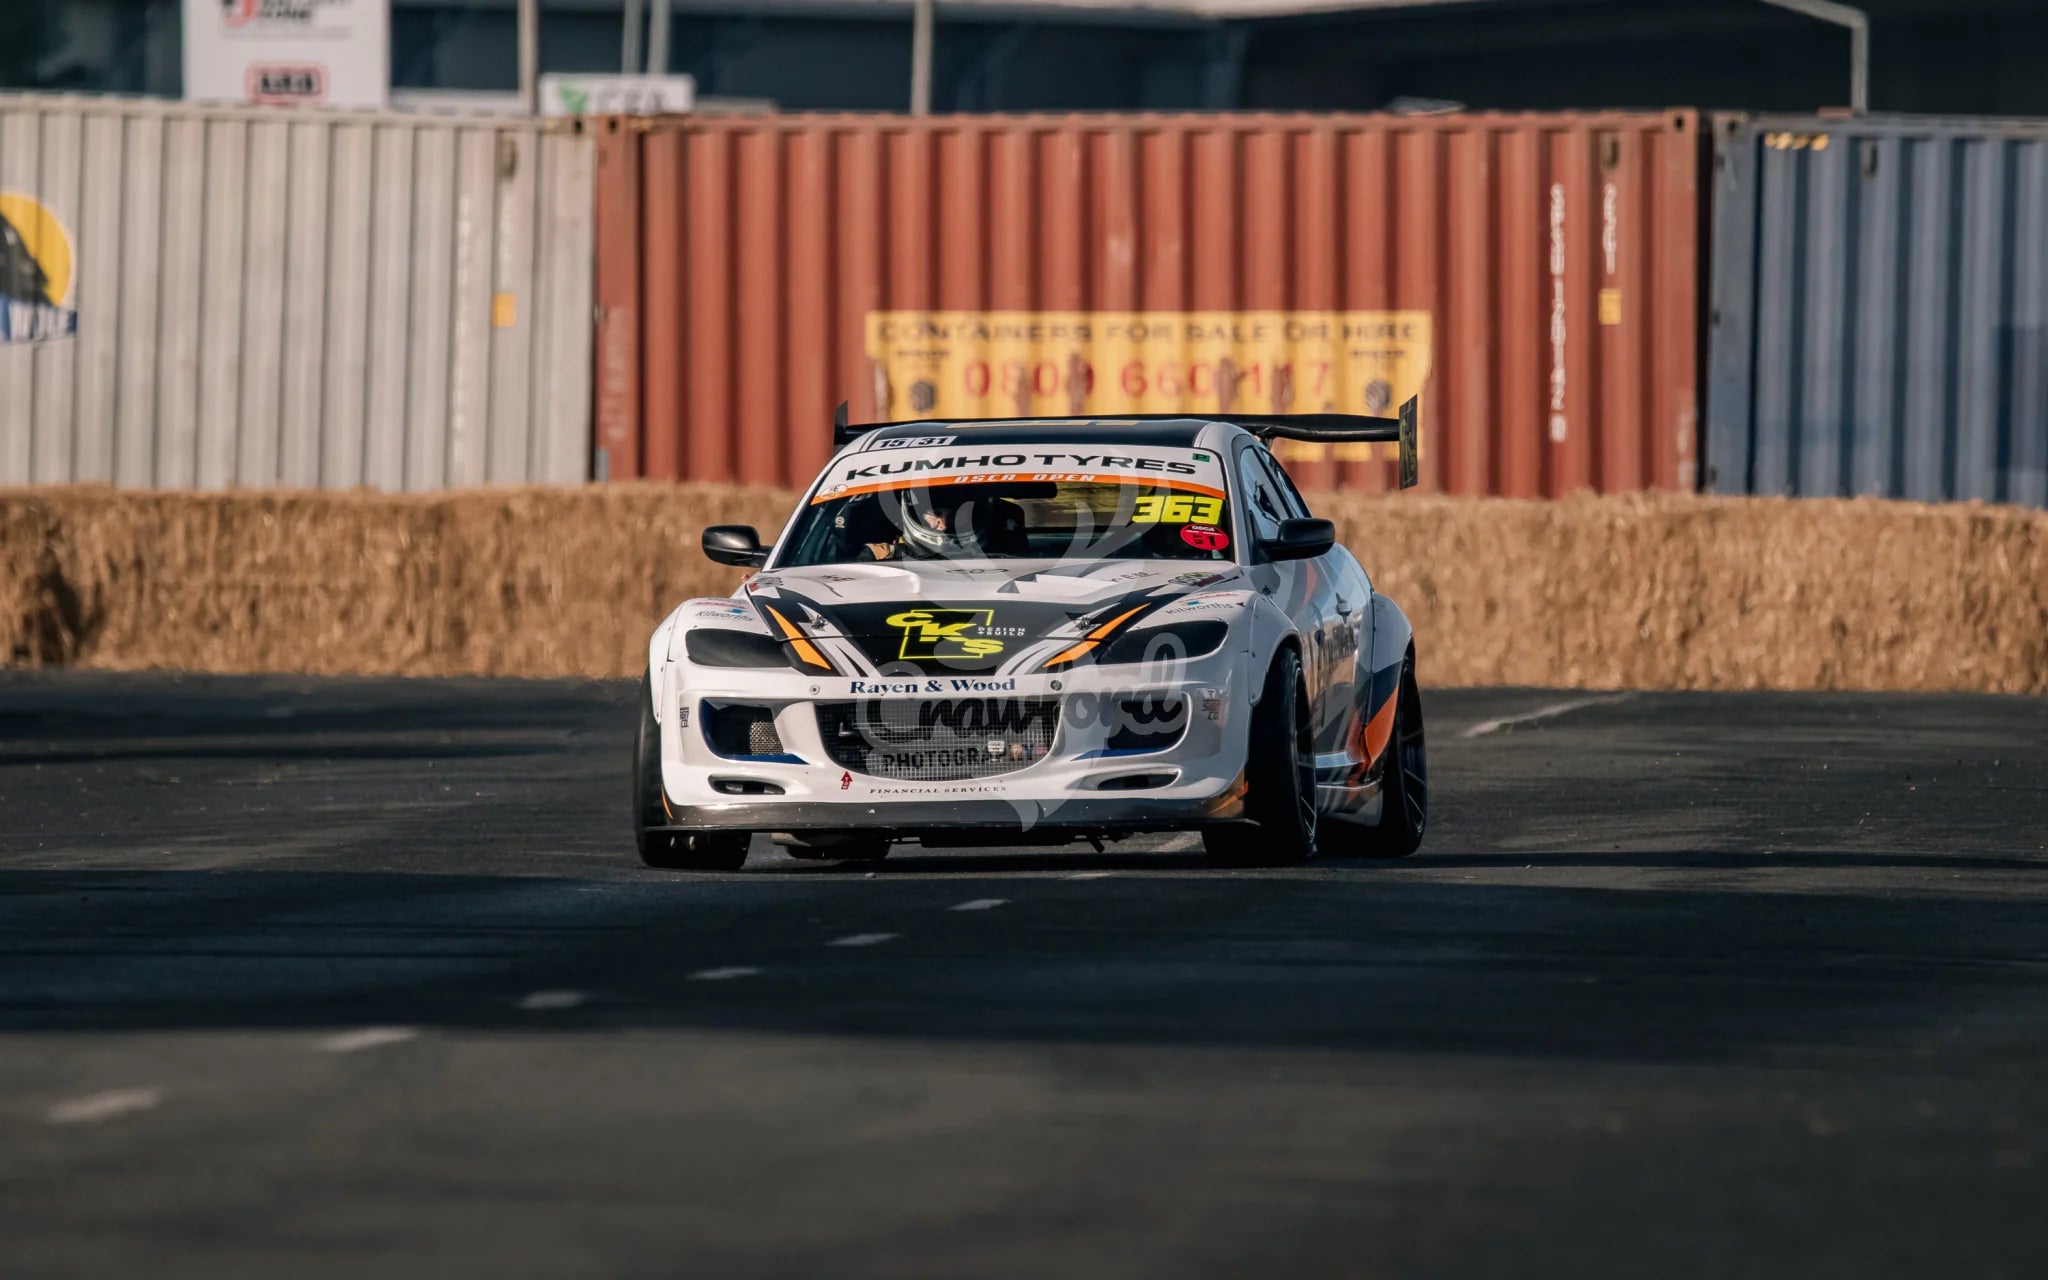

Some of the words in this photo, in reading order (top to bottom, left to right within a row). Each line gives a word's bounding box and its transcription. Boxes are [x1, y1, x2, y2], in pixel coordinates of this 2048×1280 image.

[878, 321, 1093, 342] CONTAINERS
[1106, 321, 1173, 341] FOR
[1185, 321, 1270, 342] SALE
[1285, 321, 1329, 341] OR
[1342, 321, 1418, 341] HIRE
[1121, 361, 1213, 398] 660
[878, 437, 907, 449] 15
[917, 435, 949, 447] 31
[846, 454, 1027, 481] KUMHO
[1033, 454, 1196, 475] TYRES
[953, 474, 1017, 484] OSCA
[1032, 473, 1096, 483] OPEN
[1131, 496, 1223, 526] 363
[695, 610, 753, 622] Kilworths
[1165, 602, 1234, 615] Kilworths
[850, 681, 918, 696] Rayen
[924, 680, 944, 693] &
[950, 678, 1016, 692] Wood
[944, 785, 1007, 794] SERVICES
